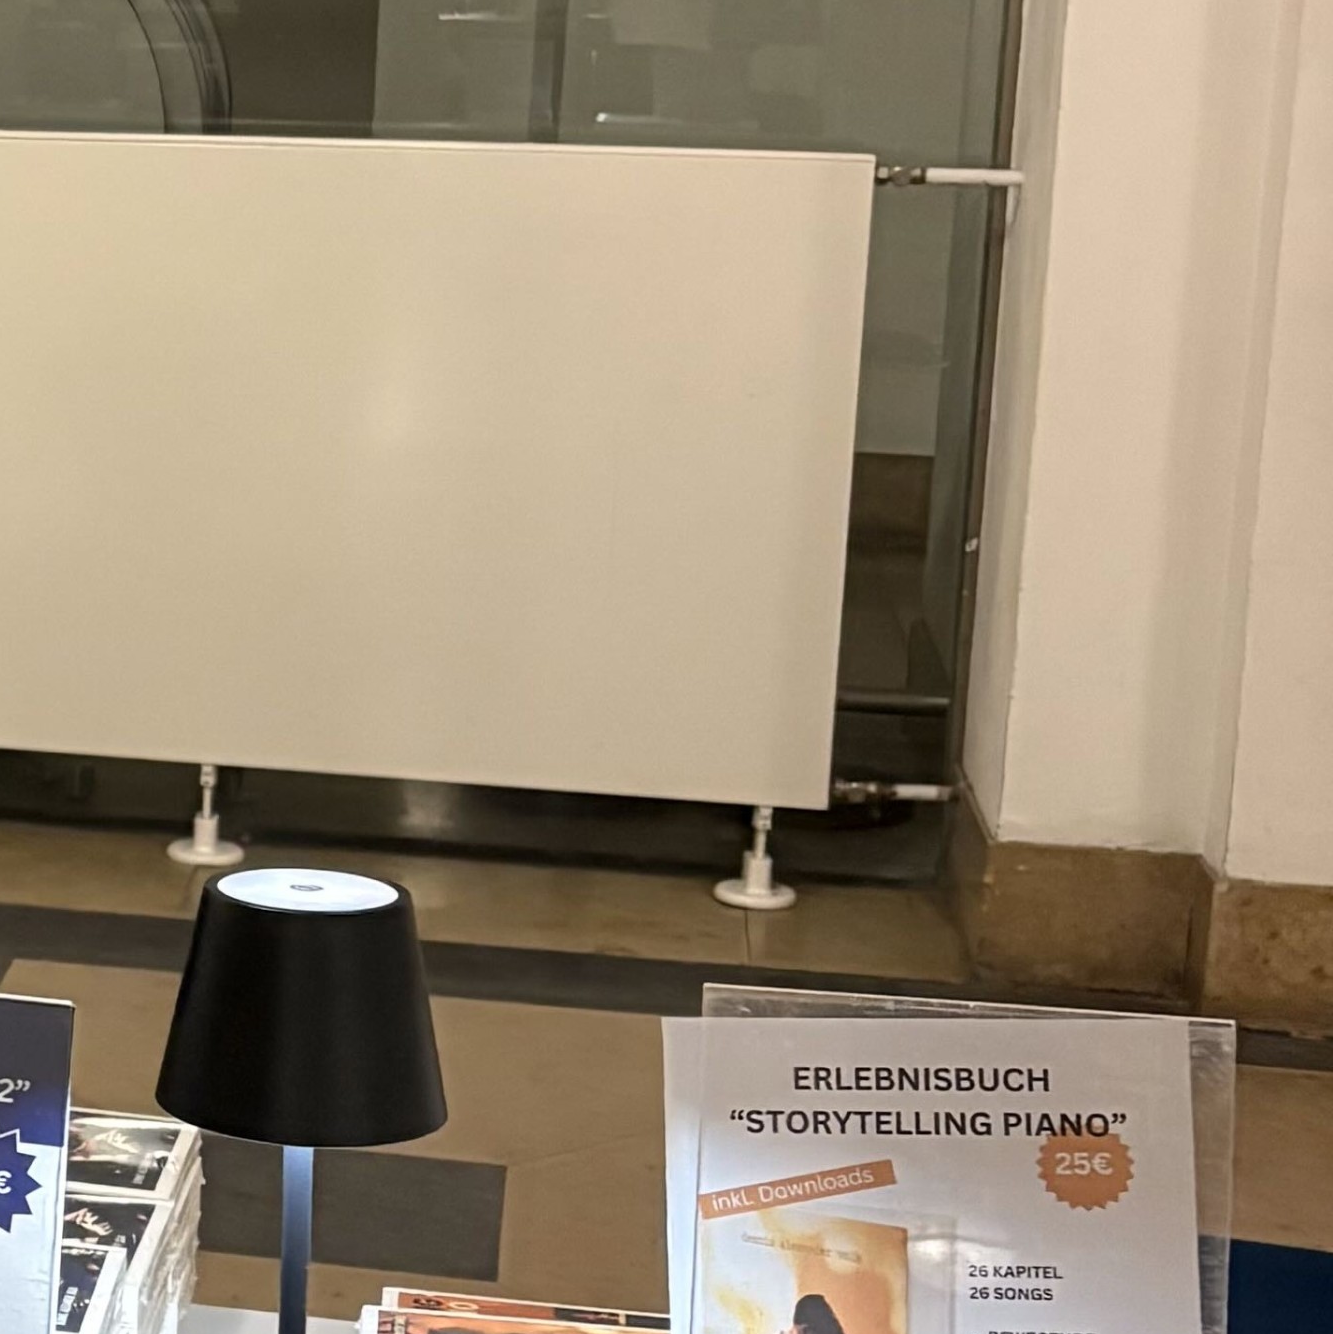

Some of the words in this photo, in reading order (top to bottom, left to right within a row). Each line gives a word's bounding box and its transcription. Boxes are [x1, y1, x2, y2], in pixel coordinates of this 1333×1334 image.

[792, 1066, 1051, 1094] ERLEBNISBUCH
[1054, 1152, 1114, 1177] 25€
[712, 1187, 753, 1213] inkl.
[758, 1166, 875, 1205] Downloads
[968, 1265, 989, 1278] 26
[992, 1265, 1063, 1280] KAPITEL
[969, 1287, 989, 1300] 26
[993, 1286, 1054, 1302] SONGS
